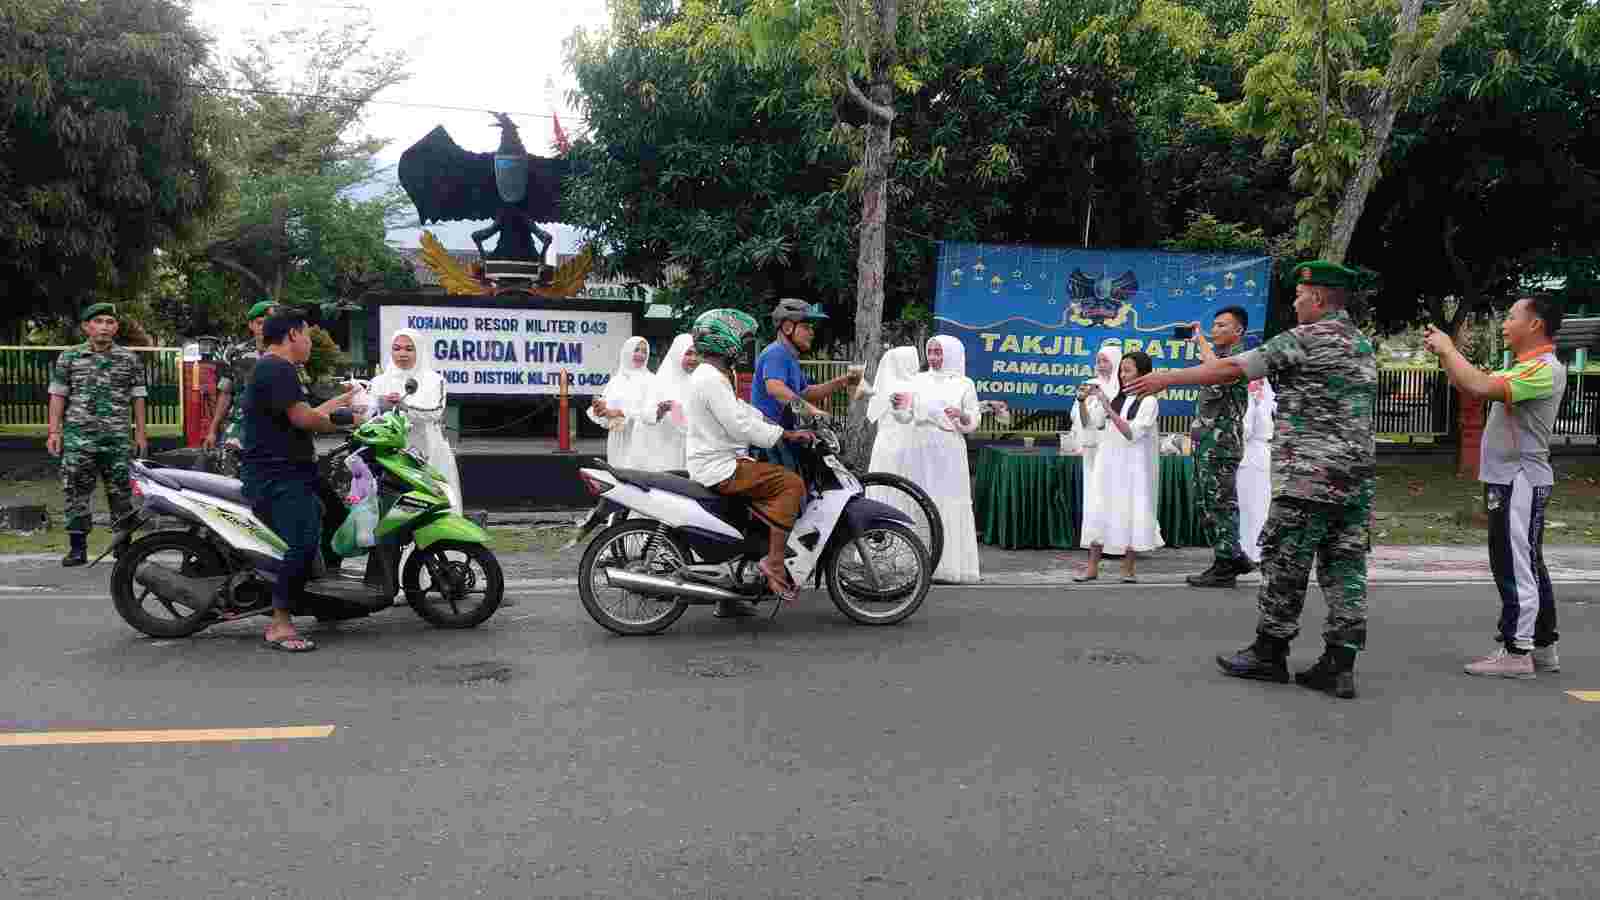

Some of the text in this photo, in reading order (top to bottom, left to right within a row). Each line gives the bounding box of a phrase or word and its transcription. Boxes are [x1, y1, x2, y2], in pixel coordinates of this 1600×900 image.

[407, 315, 608, 335] KOMANDO RESOR MILITER 043
[433, 340, 584, 364] GARUDA HITAM
[980, 332, 1089, 357] TAKJIL
[992, 359, 1099, 377] RAMADHA
[473, 370, 524, 385] DISTRIK
[527, 371, 575, 387] MILITR
[976, 380, 1038, 395] KODIM
[1043, 382, 1075, 397] 042
